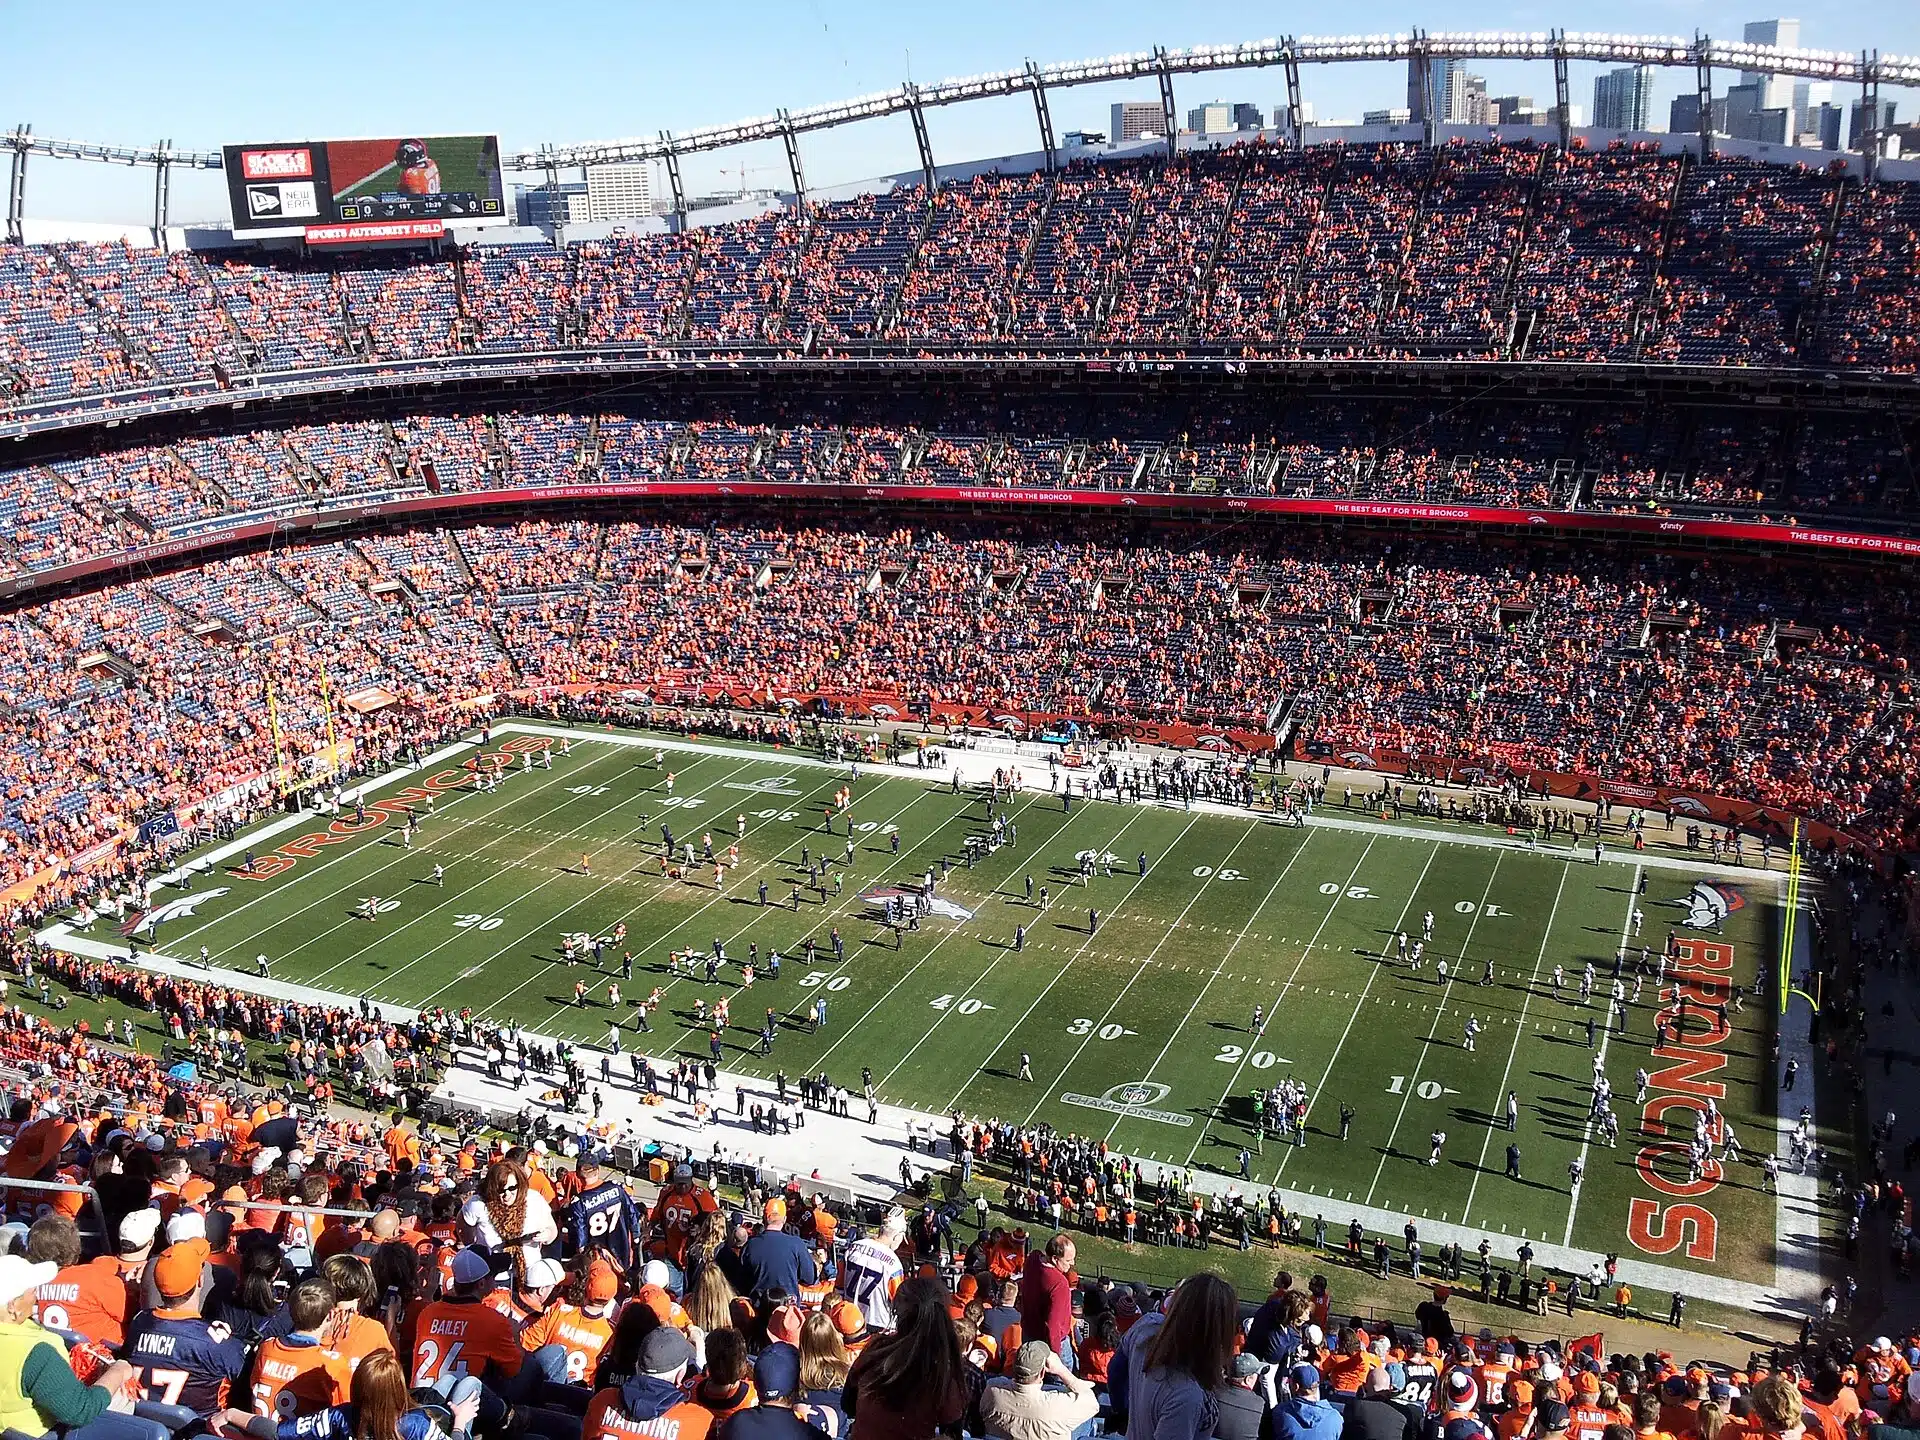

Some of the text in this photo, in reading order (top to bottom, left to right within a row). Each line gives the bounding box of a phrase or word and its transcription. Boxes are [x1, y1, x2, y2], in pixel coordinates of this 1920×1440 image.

[248, 152, 306, 168] SPORTS
[344, 208, 356, 216] 25
[363, 205, 371, 214] 0
[469, 201, 476, 210] 0
[308, 224, 442, 240] SPORTS AUTHORITY FIELD
[204, 395, 234, 405] JACKSON
[105, 411, 124, 420] LITTLE
[361, 506, 380, 516] xfinity
[1429, 509, 1469, 517] BRONCOS
[1660, 522, 1684, 532] xfinity
[111, 532, 235, 565] THE BEST SEAT FOR THE BRONCOS
[1790, 532, 1809, 540] THE
[1810, 534, 1834, 542] BEST
[1836, 536, 1860, 545] SEAT
[1862, 538, 1882, 547] FOR
[1884, 541, 1902, 549] THE
[15, 578, 35, 590] xfinity
[229, 784, 246, 799] TO
[1599, 782, 1656, 797] CHAMPIONSHIP
[226, 735, 554, 881] BRONCOS
[148, 818, 174, 836] 12:29
[1192, 866, 1240, 880] 30
[1319, 883, 1370, 898] 20
[1454, 901, 1502, 916] 10
[452, 914, 504, 931] 20
[798, 970, 851, 991] 50
[928, 994, 982, 1015] 40
[1066, 1018, 1123, 1040] 30
[1214, 1045, 1276, 1068] 20
[1385, 1076, 1442, 1099] 10
[1626, 937, 1734, 1262] BRONCOS
[202, 1110, 215, 1123] 18
[1068, 1096, 1188, 1125] CHAMPIONSHIP
[589, 1202, 622, 1237] 87
[666, 1206, 692, 1232] 95
[36, 1283, 80, 1300] ANNING
[846, 1262, 884, 1306] 77
[430, 1318, 468, 1336] BAILEY
[137, 1333, 176, 1356] LYNCH
[262, 1360, 298, 1380] MILLER
[414, 1338, 469, 1388] 24
[1405, 1382, 1432, 1404] 84
[1486, 1380, 1503, 1405] 18
[253, 1383, 298, 1422] 58
[601, 1405, 680, 1440] MANNING
[1578, 1411, 1607, 1422] ELWAY
